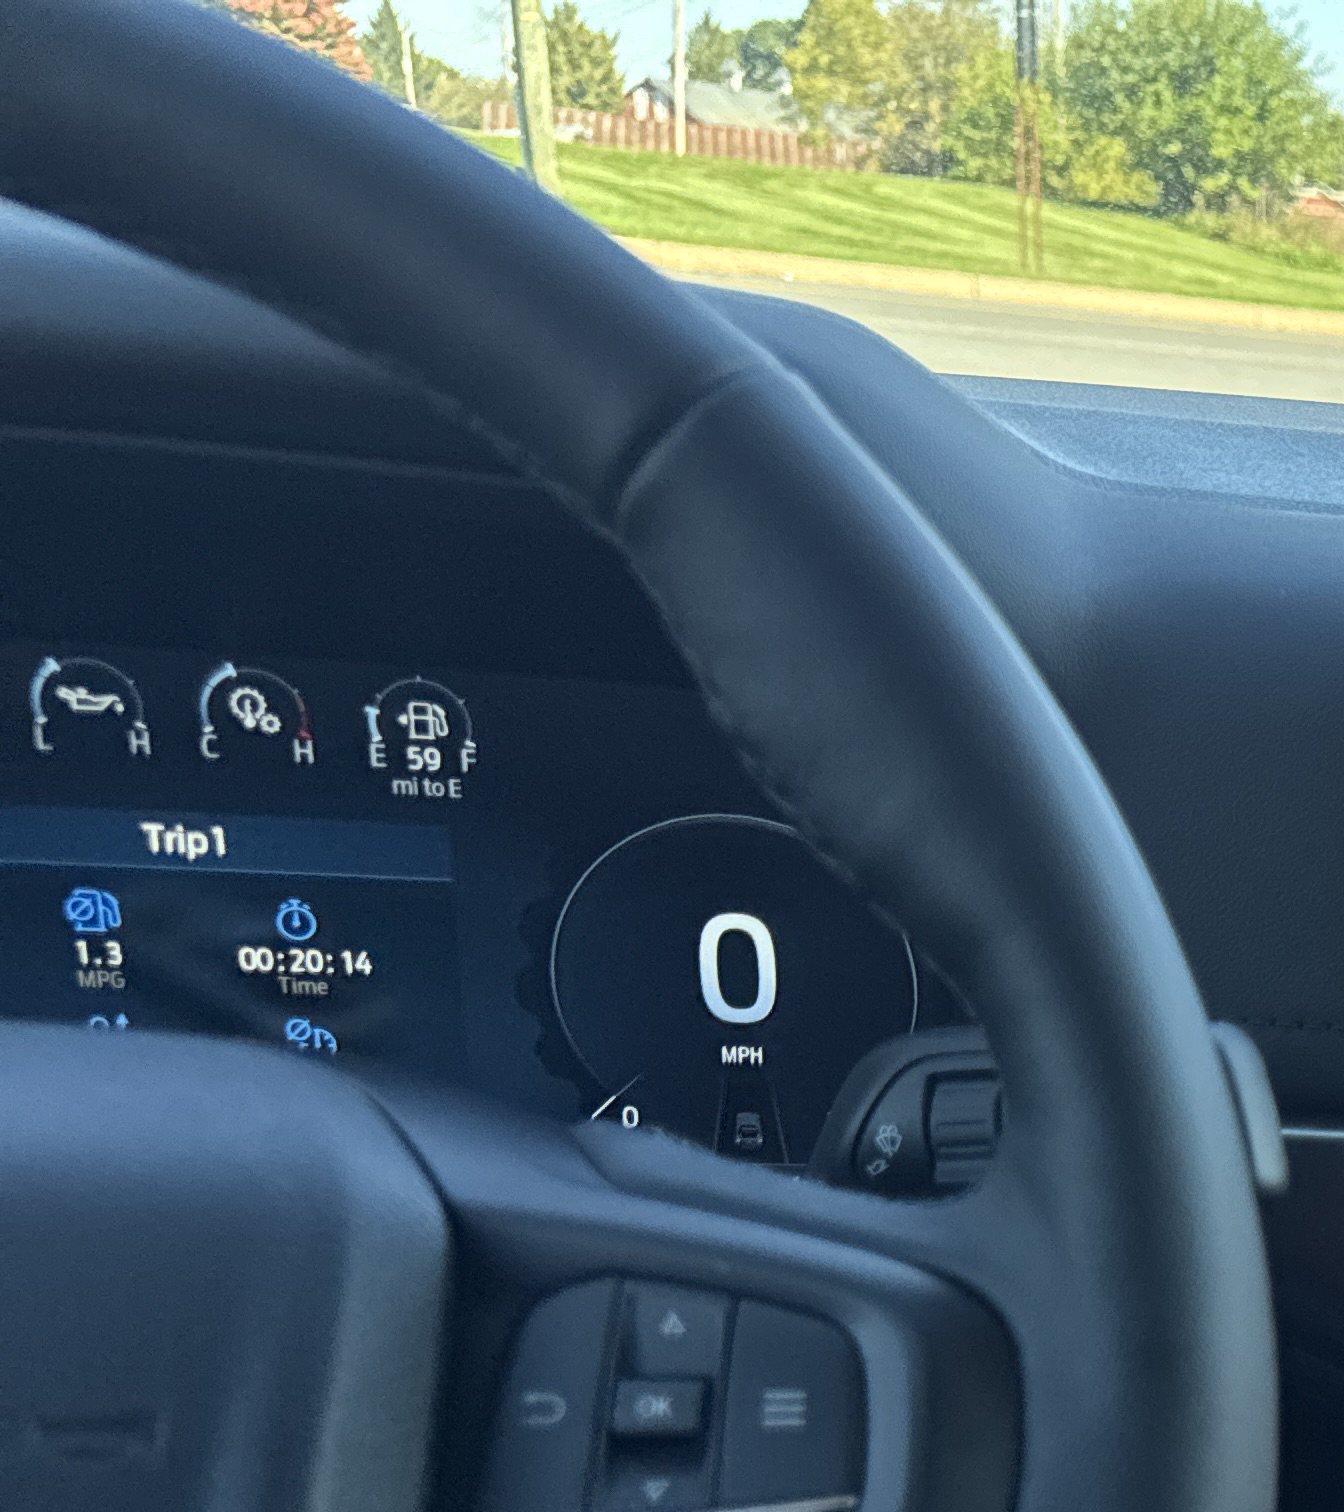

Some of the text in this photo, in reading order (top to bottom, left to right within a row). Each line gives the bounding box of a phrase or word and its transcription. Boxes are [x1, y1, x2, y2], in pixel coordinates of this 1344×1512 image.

[127, 729, 152, 756] H
[201, 733, 221, 759] C
[292, 738, 316, 765] H
[370, 743, 388, 768] E
[406, 746, 442, 772] 59
[461, 747, 477, 774] F
[392, 777, 463, 799] mi to E
[75, 940, 123, 967] 1.3
[237, 945, 373, 977] 00:20:14
[75, 969, 126, 990] MPG
[699, 912, 777, 1024] 0
[277, 975, 329, 996] Time
[721, 1045, 764, 1067] MPH
[622, 1105, 640, 1129] 0
